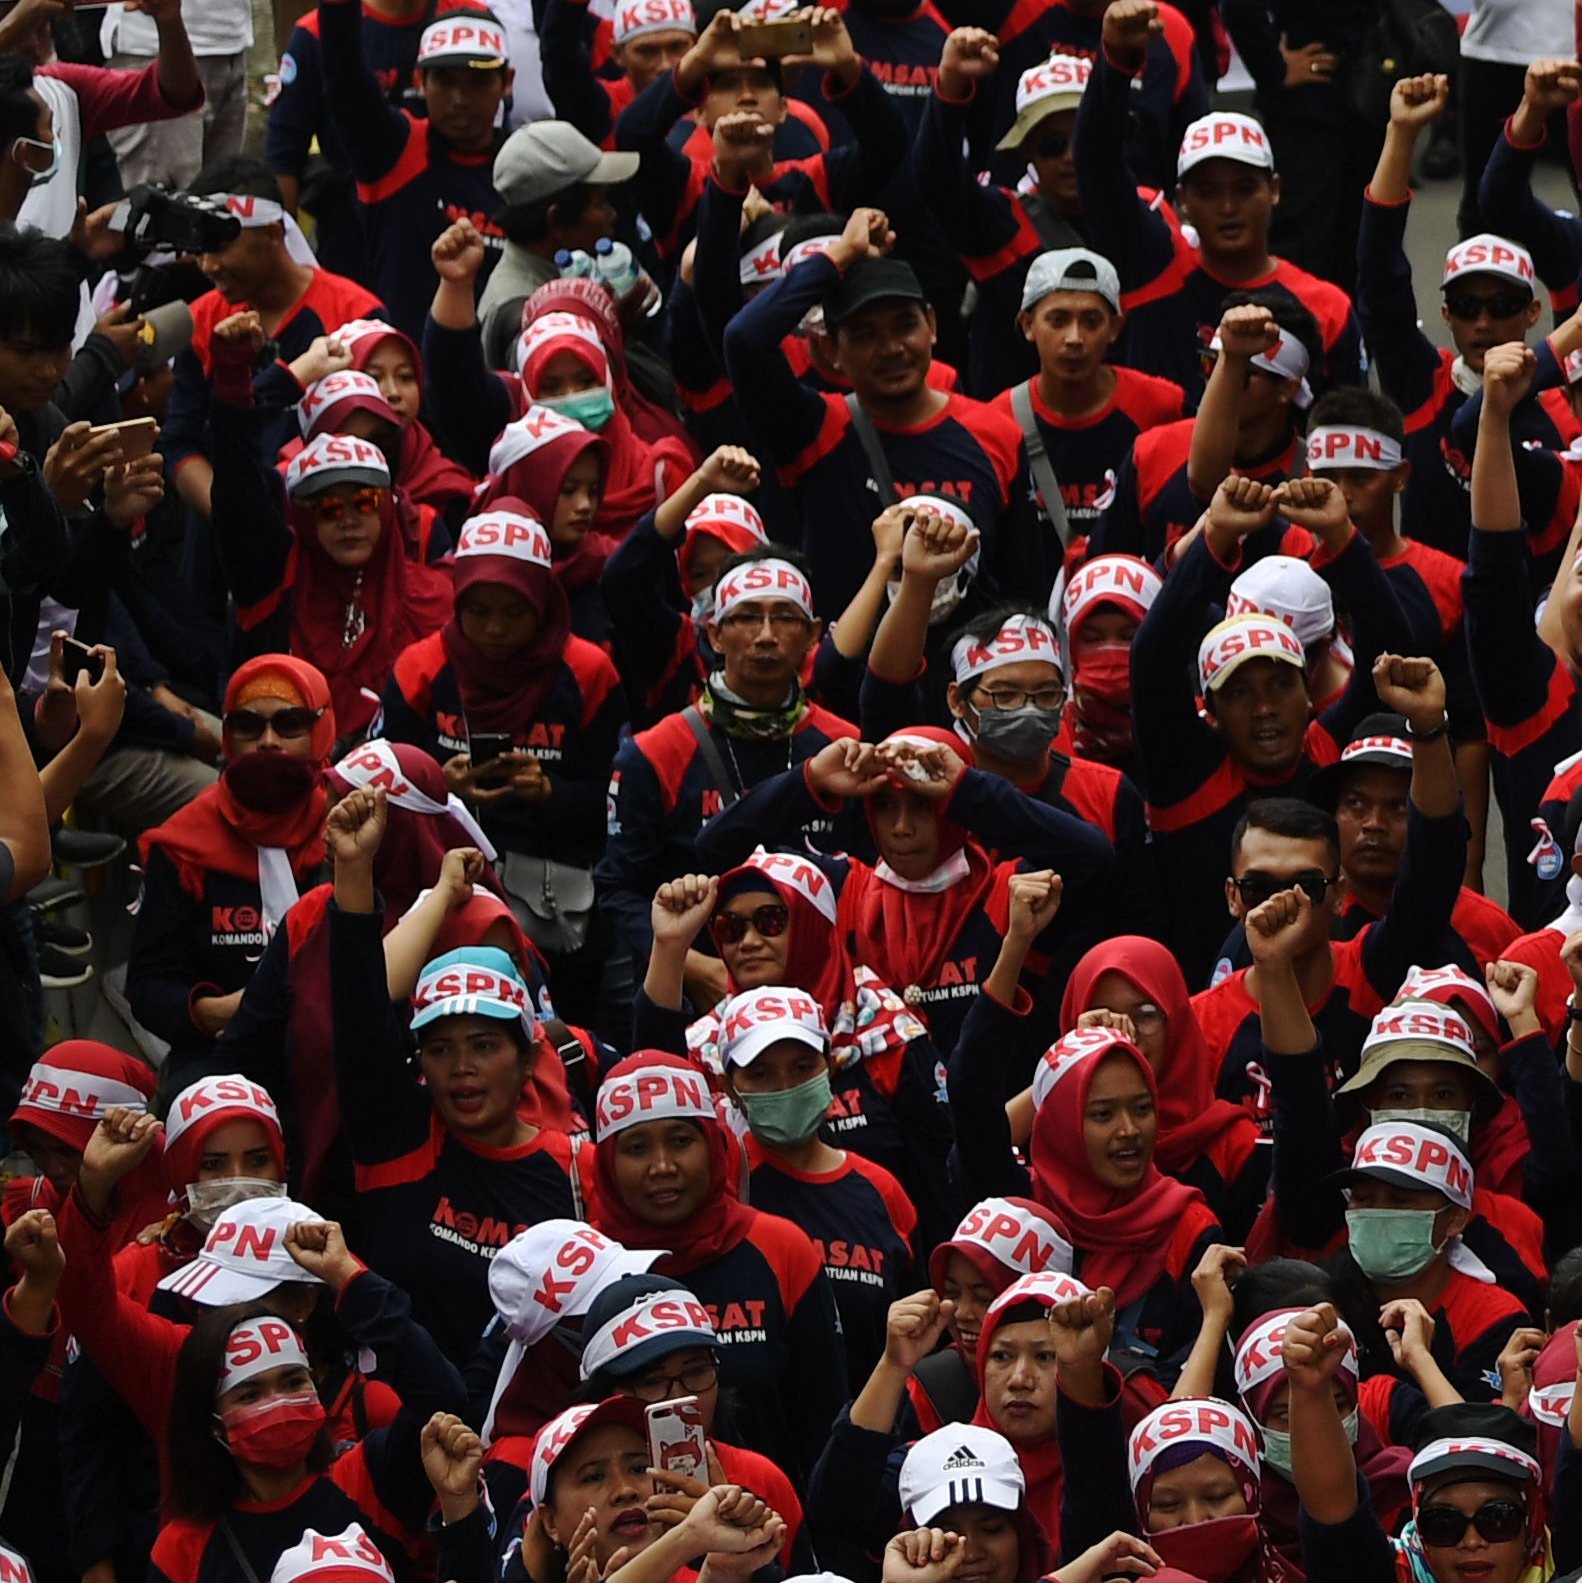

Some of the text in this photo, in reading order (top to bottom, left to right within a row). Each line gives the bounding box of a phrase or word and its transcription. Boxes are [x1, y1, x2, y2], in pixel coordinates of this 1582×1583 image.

[419, 27, 501, 59] SPN
[1022, 56, 1092, 93] KSP
[1062, 564, 1146, 618] SPN
[1199, 631, 1303, 678] KSPN
[951, 982, 980, 999] KSPN
[19, 1075, 100, 1119] SPN
[179, 1081, 275, 1121] KSP
[838, 1113, 868, 1132] KSPN
[1355, 1134, 1470, 1197] KSPN
[958, 1208, 1055, 1272] SPN
[533, 1222, 605, 1313] KSP
[857, 1269, 885, 1288] KSPN
[612, 1300, 710, 1348] KSP
[737, 1328, 767, 1344] KSPN
[942, 1459, 986, 1471] adidas
